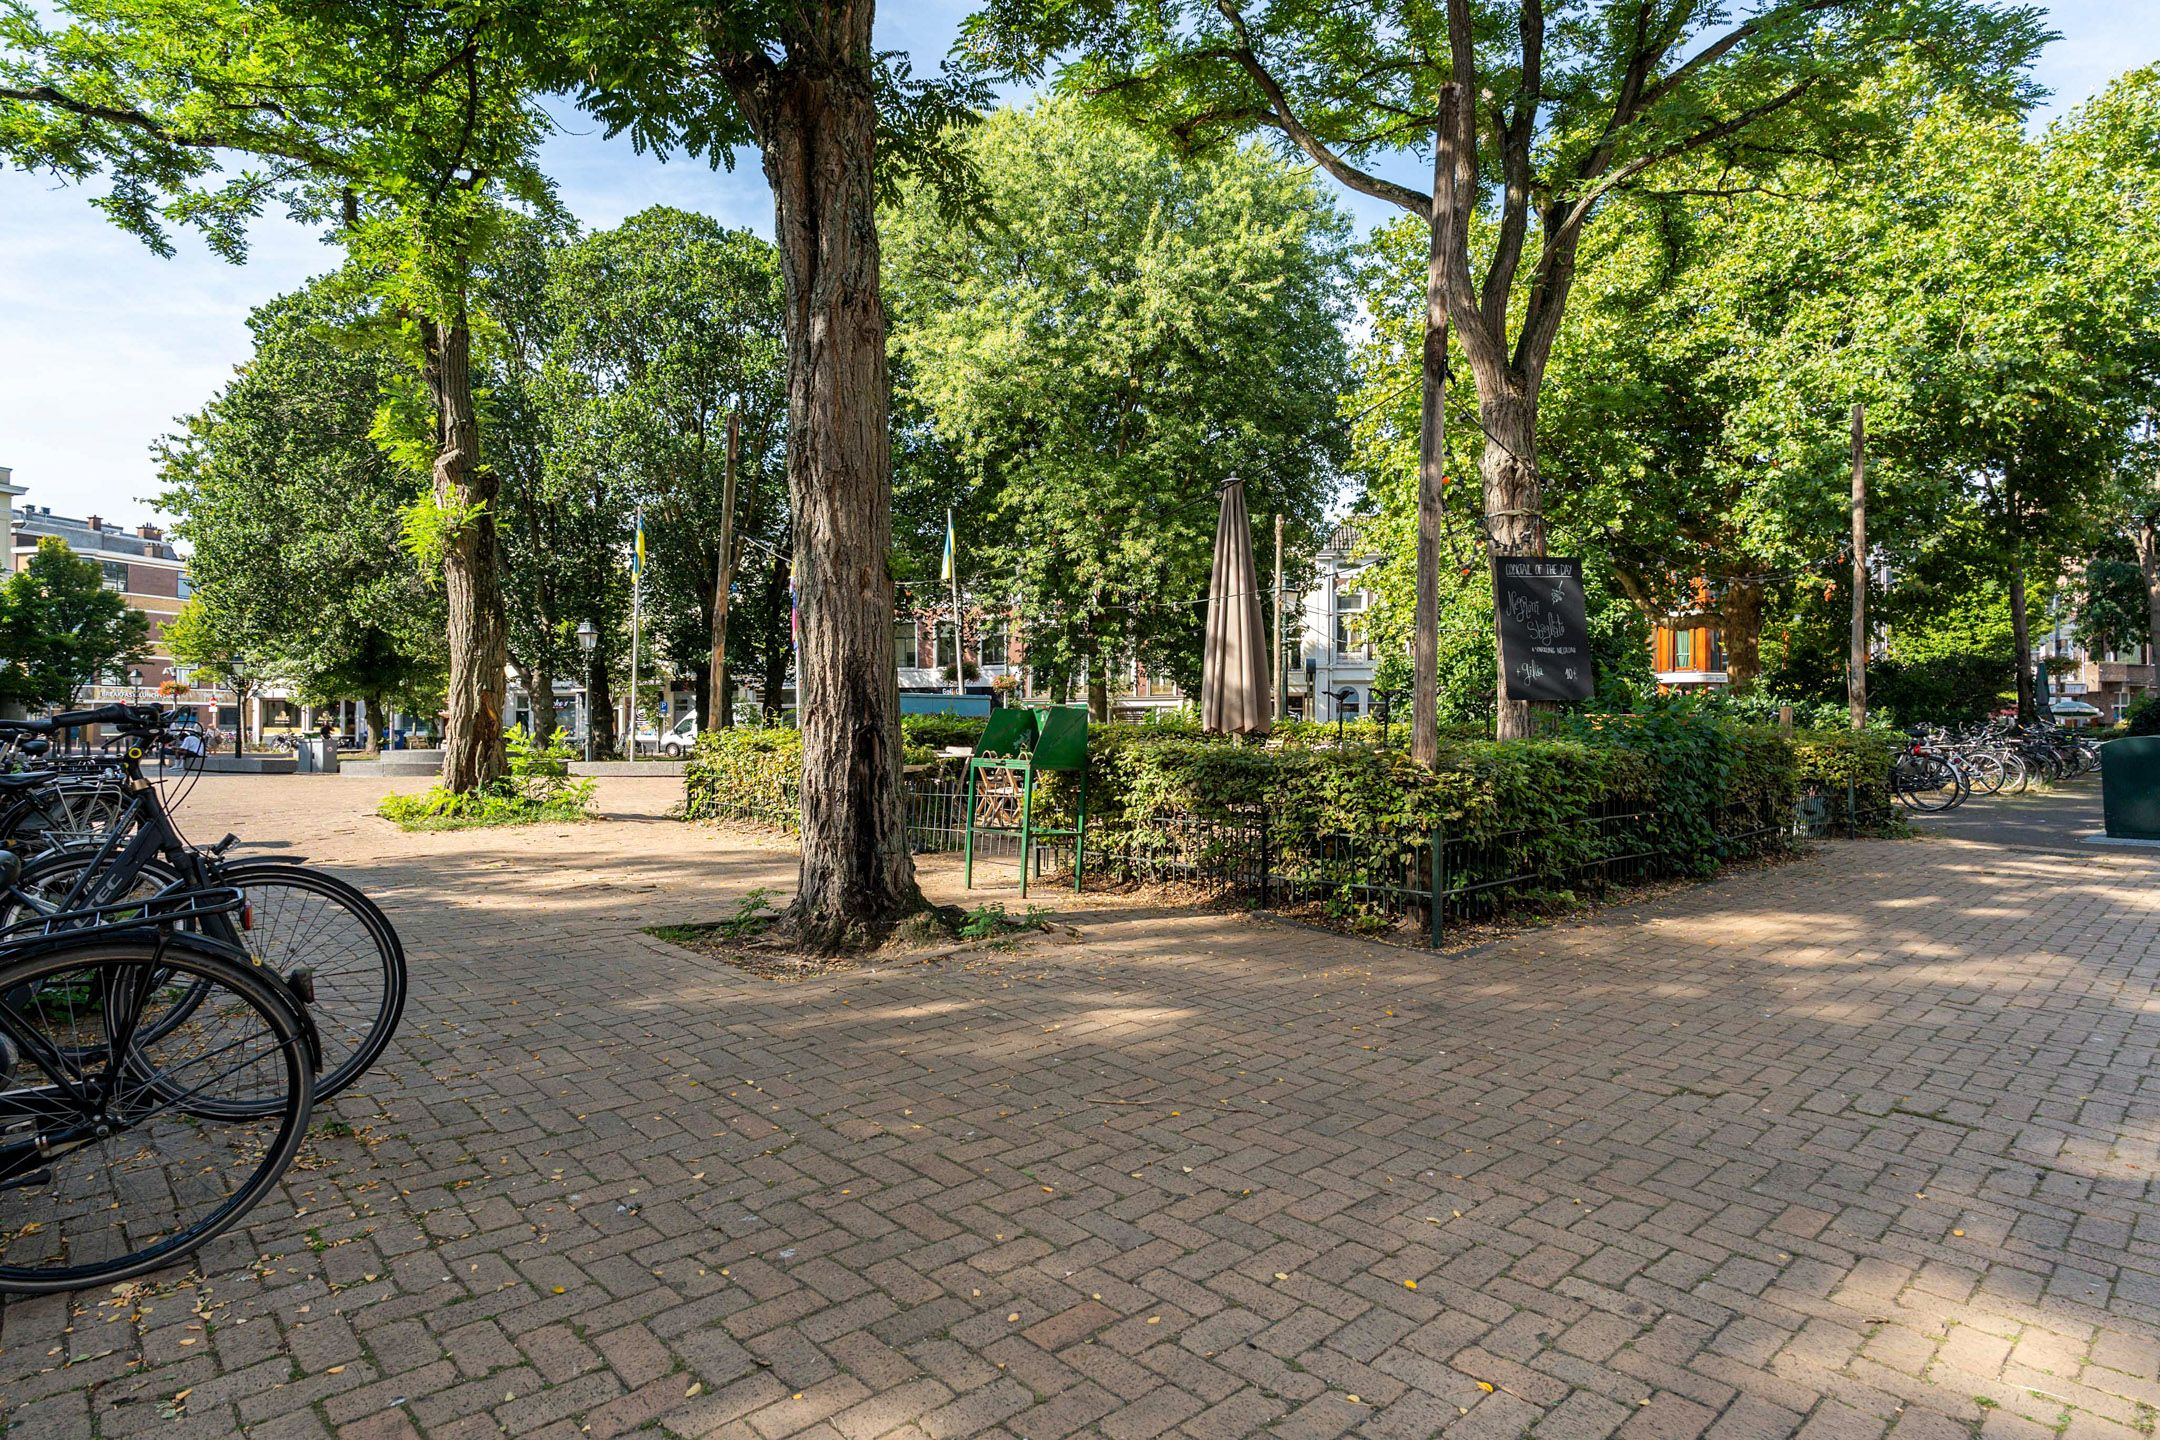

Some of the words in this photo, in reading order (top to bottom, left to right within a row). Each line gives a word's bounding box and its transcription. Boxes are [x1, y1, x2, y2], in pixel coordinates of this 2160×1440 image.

[1505, 563, 1533, 576] COCKTAIL
[1535, 563, 1543, 575] OF
[1546, 563, 1558, 575] THE
[1560, 564, 1573, 576] DAY
